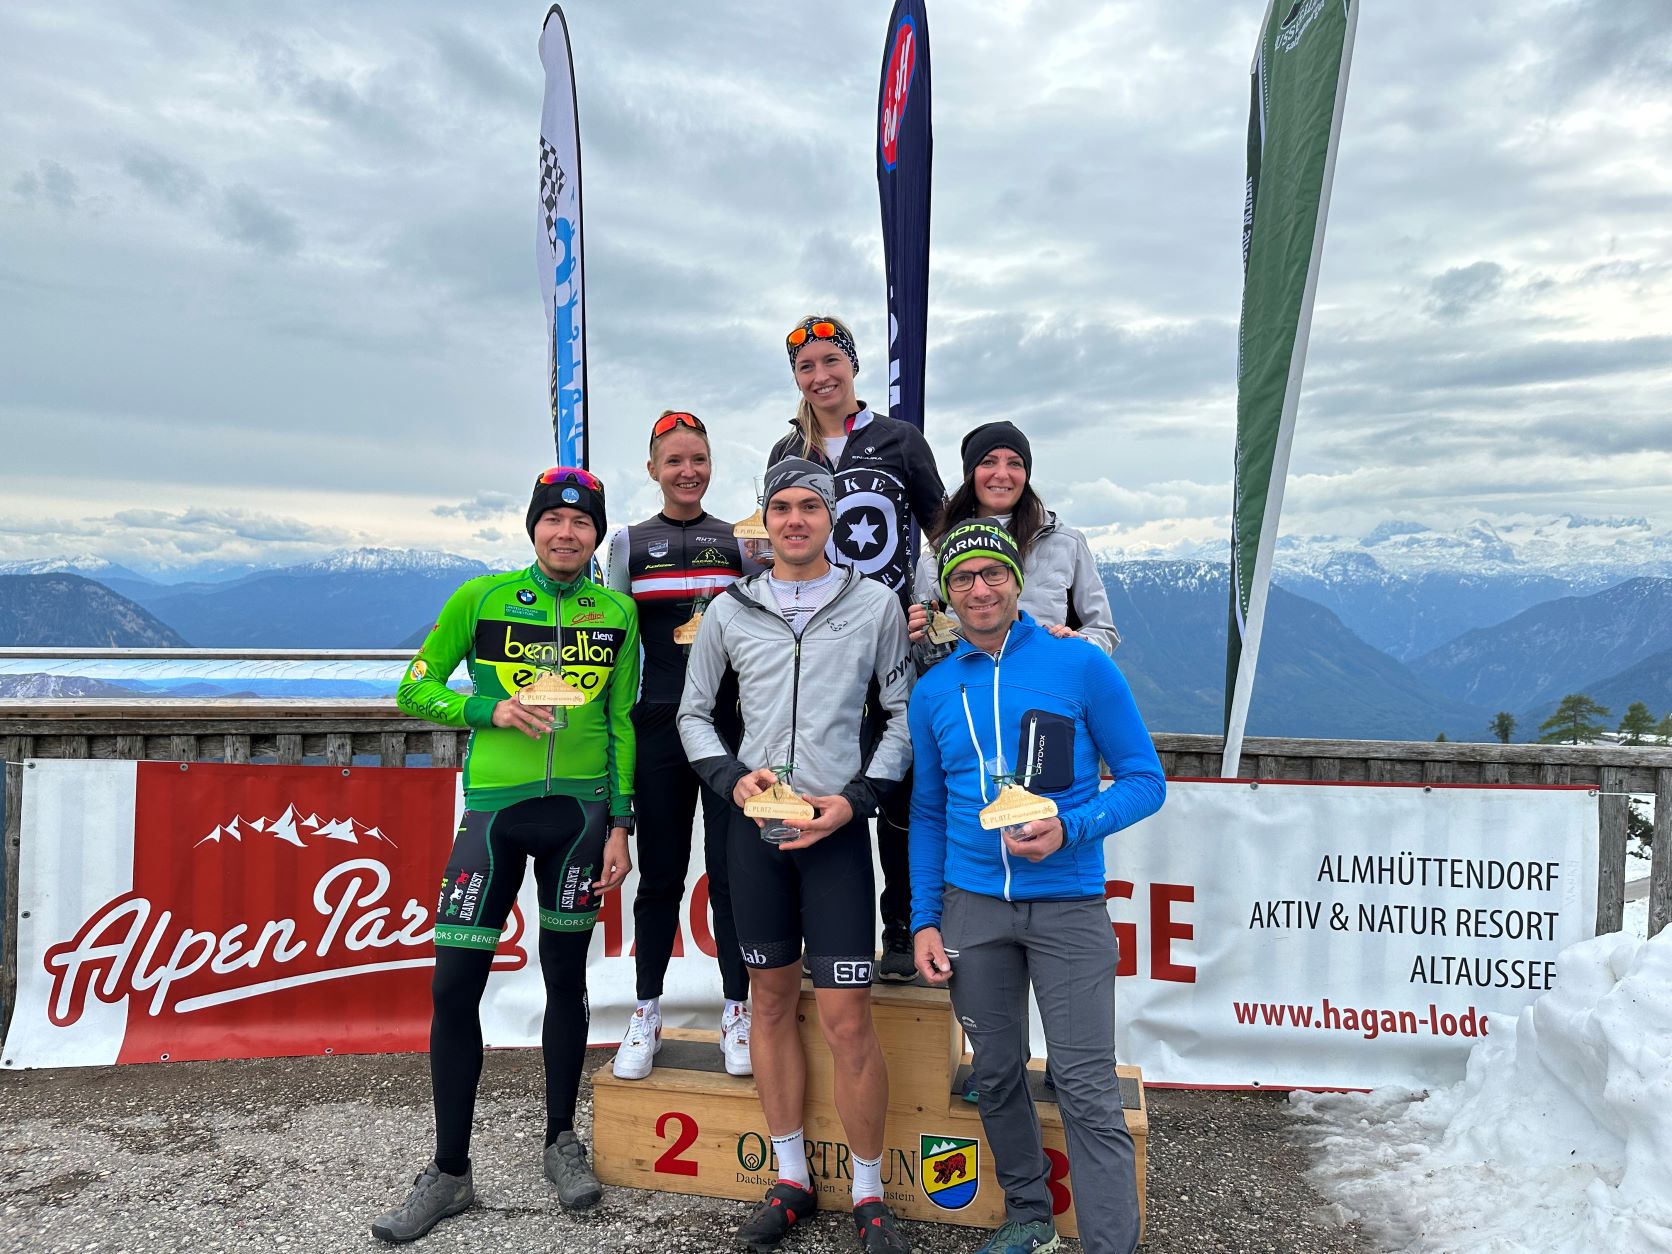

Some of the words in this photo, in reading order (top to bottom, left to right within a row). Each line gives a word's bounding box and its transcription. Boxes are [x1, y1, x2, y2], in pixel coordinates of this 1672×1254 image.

[943, 537, 1003, 565] GARMIN
[505, 625, 614, 663] benetton
[592, 631, 614, 642] Lienz
[1317, 851, 1560, 891] ALMHÜTTENDORF
[454, 933, 470, 942] OF
[1249, 901, 1322, 930] AKTIV
[1329, 902, 1349, 931] &
[1358, 904, 1447, 936] NATUR
[1456, 909, 1560, 941] RESORT
[51, 898, 307, 1020] Alpen
[1409, 955, 1558, 990] ALTAUSSEE
[654, 1112, 699, 1176] 2
